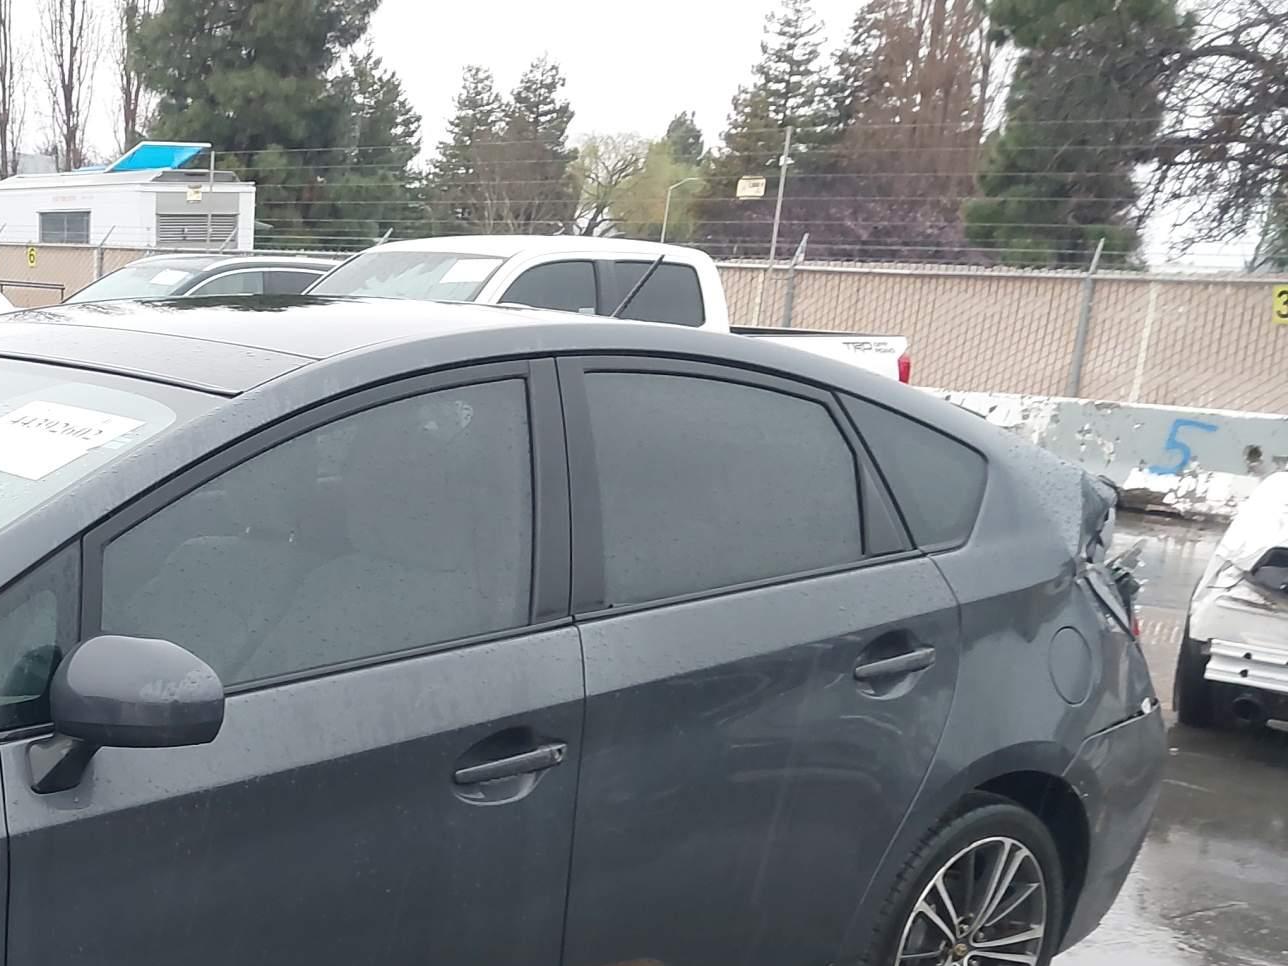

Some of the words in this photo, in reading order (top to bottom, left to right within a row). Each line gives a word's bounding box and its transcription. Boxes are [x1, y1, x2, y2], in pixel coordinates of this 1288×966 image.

[29, 248, 36, 264] 6
[1276, 290, 1288, 318] 3
[841, 341, 872, 353] TRD
[1148, 419, 1219, 475] 5
